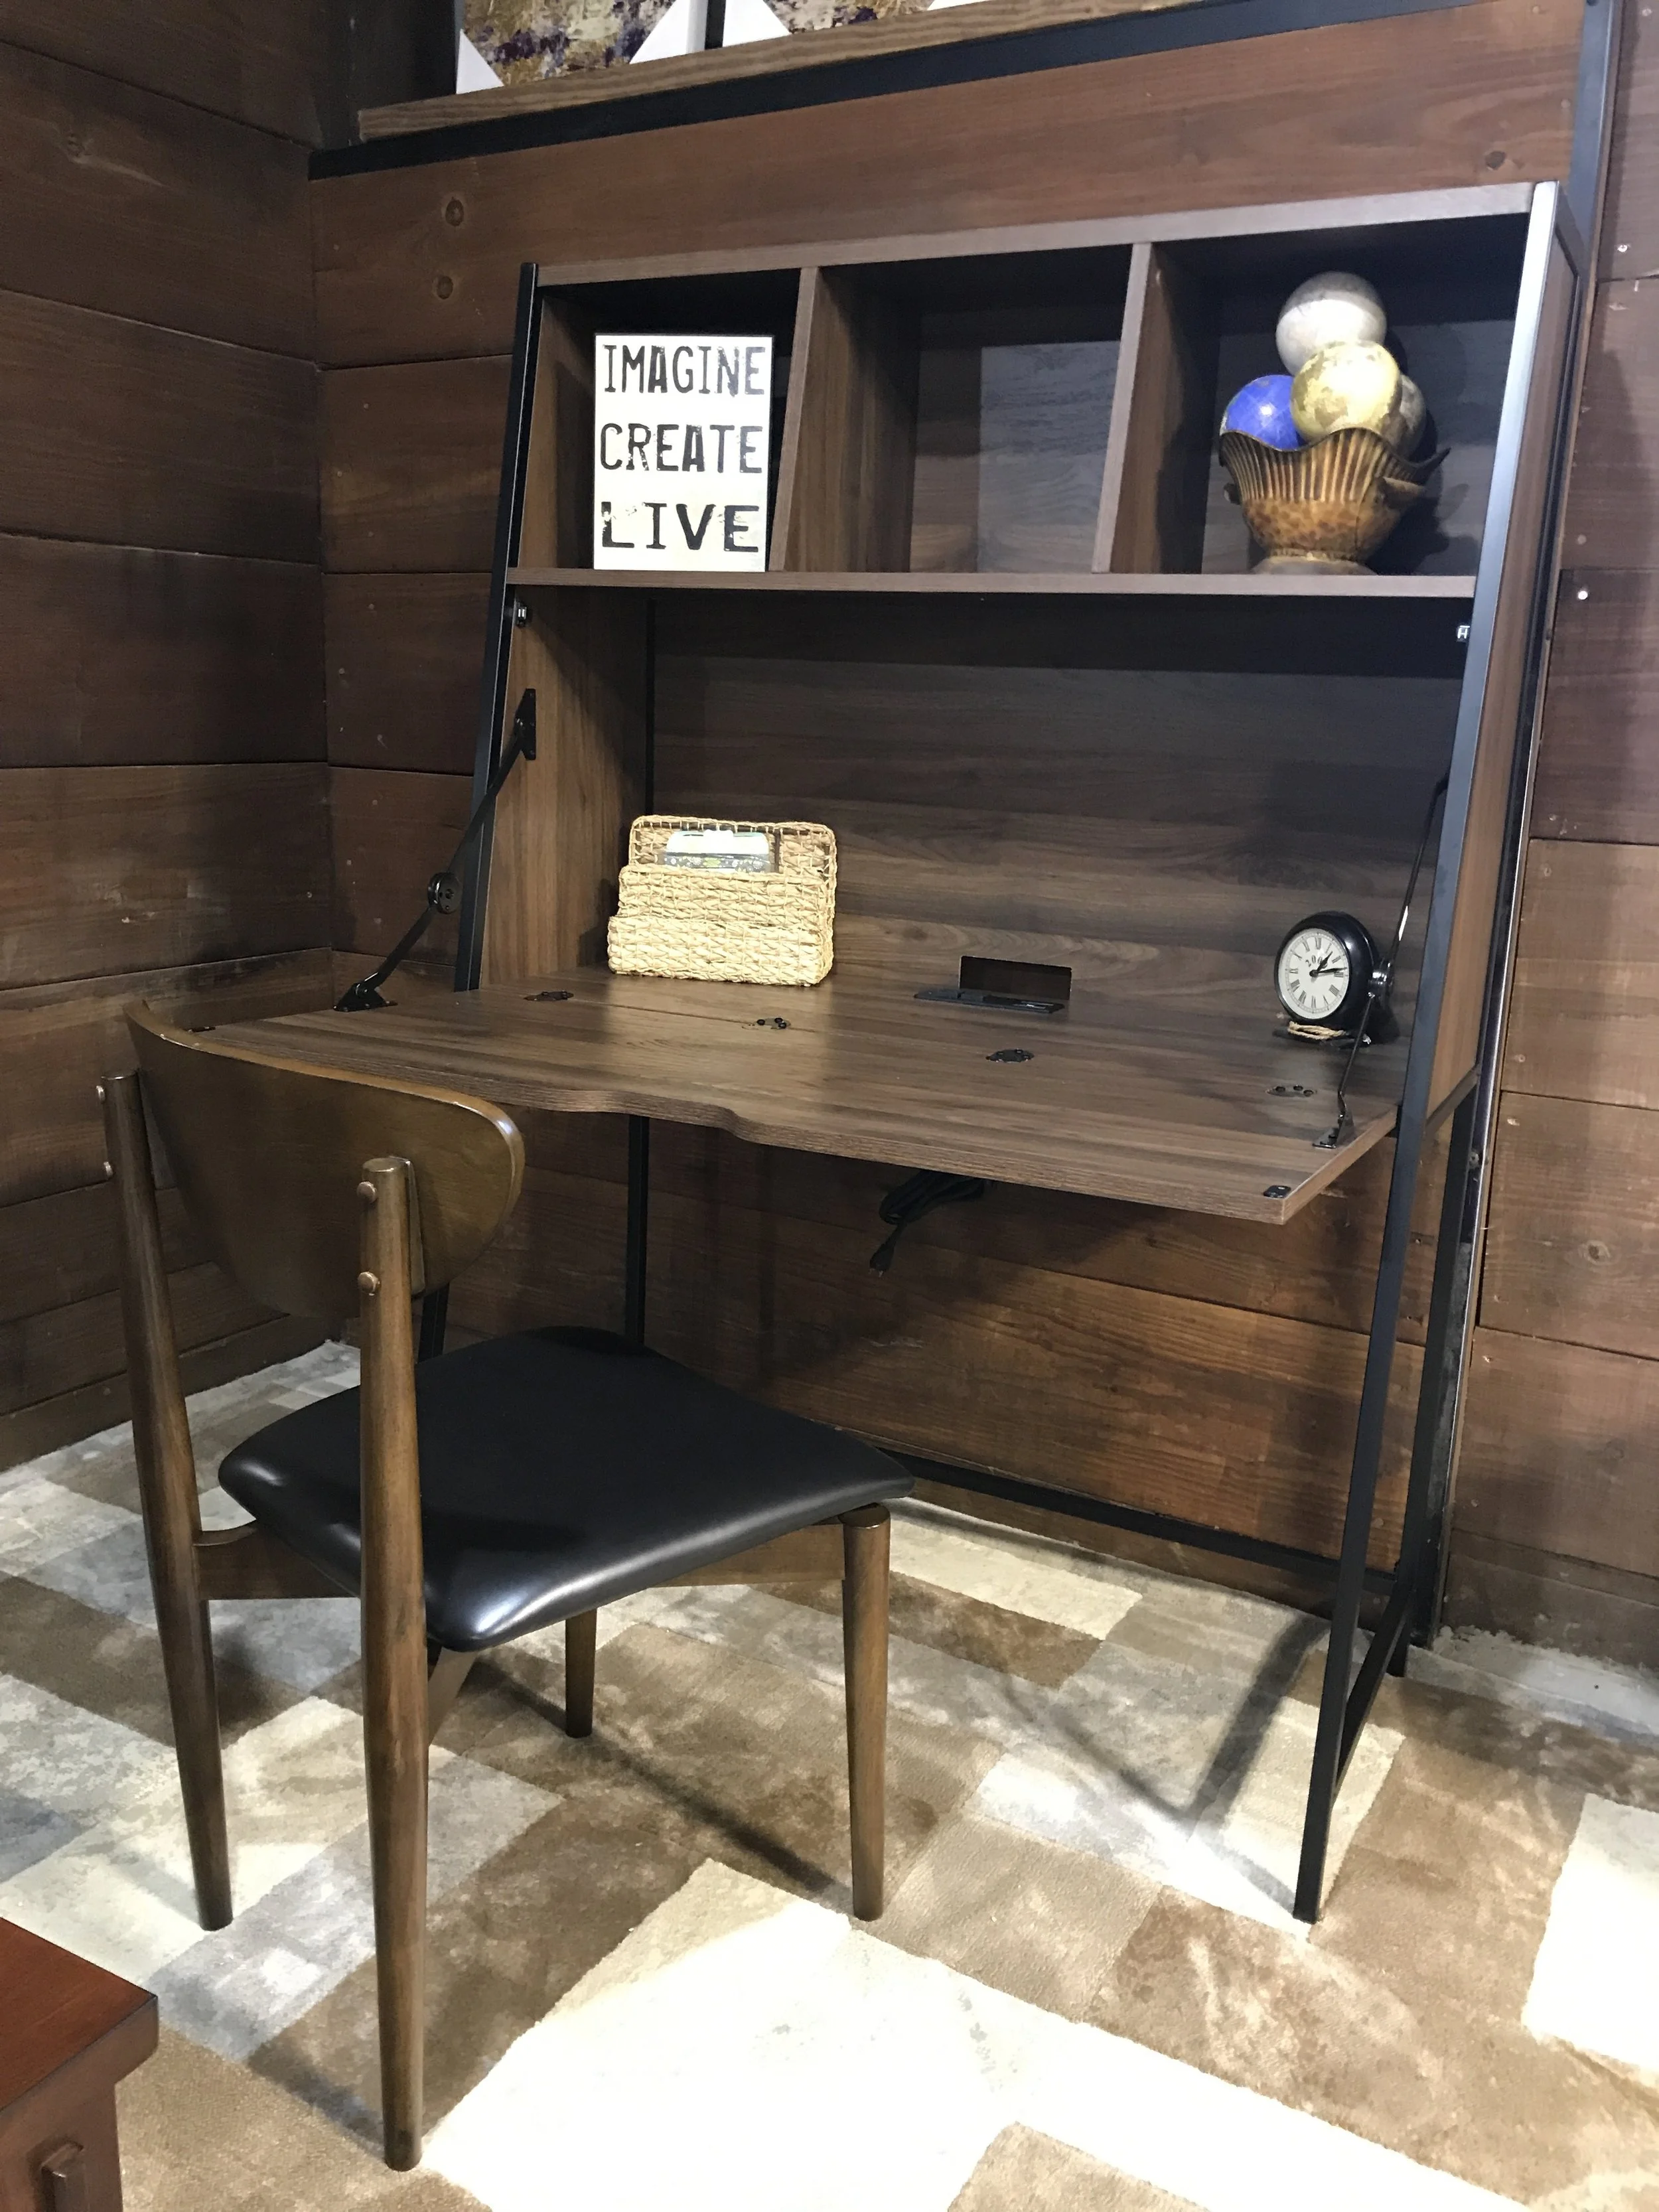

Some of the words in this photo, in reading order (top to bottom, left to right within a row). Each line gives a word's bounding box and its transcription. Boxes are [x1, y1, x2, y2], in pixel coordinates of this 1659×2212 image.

[603, 345, 766, 397] IMAGINE
[601, 423, 763, 473] CREATE
[601, 501, 760, 552] LIVE
